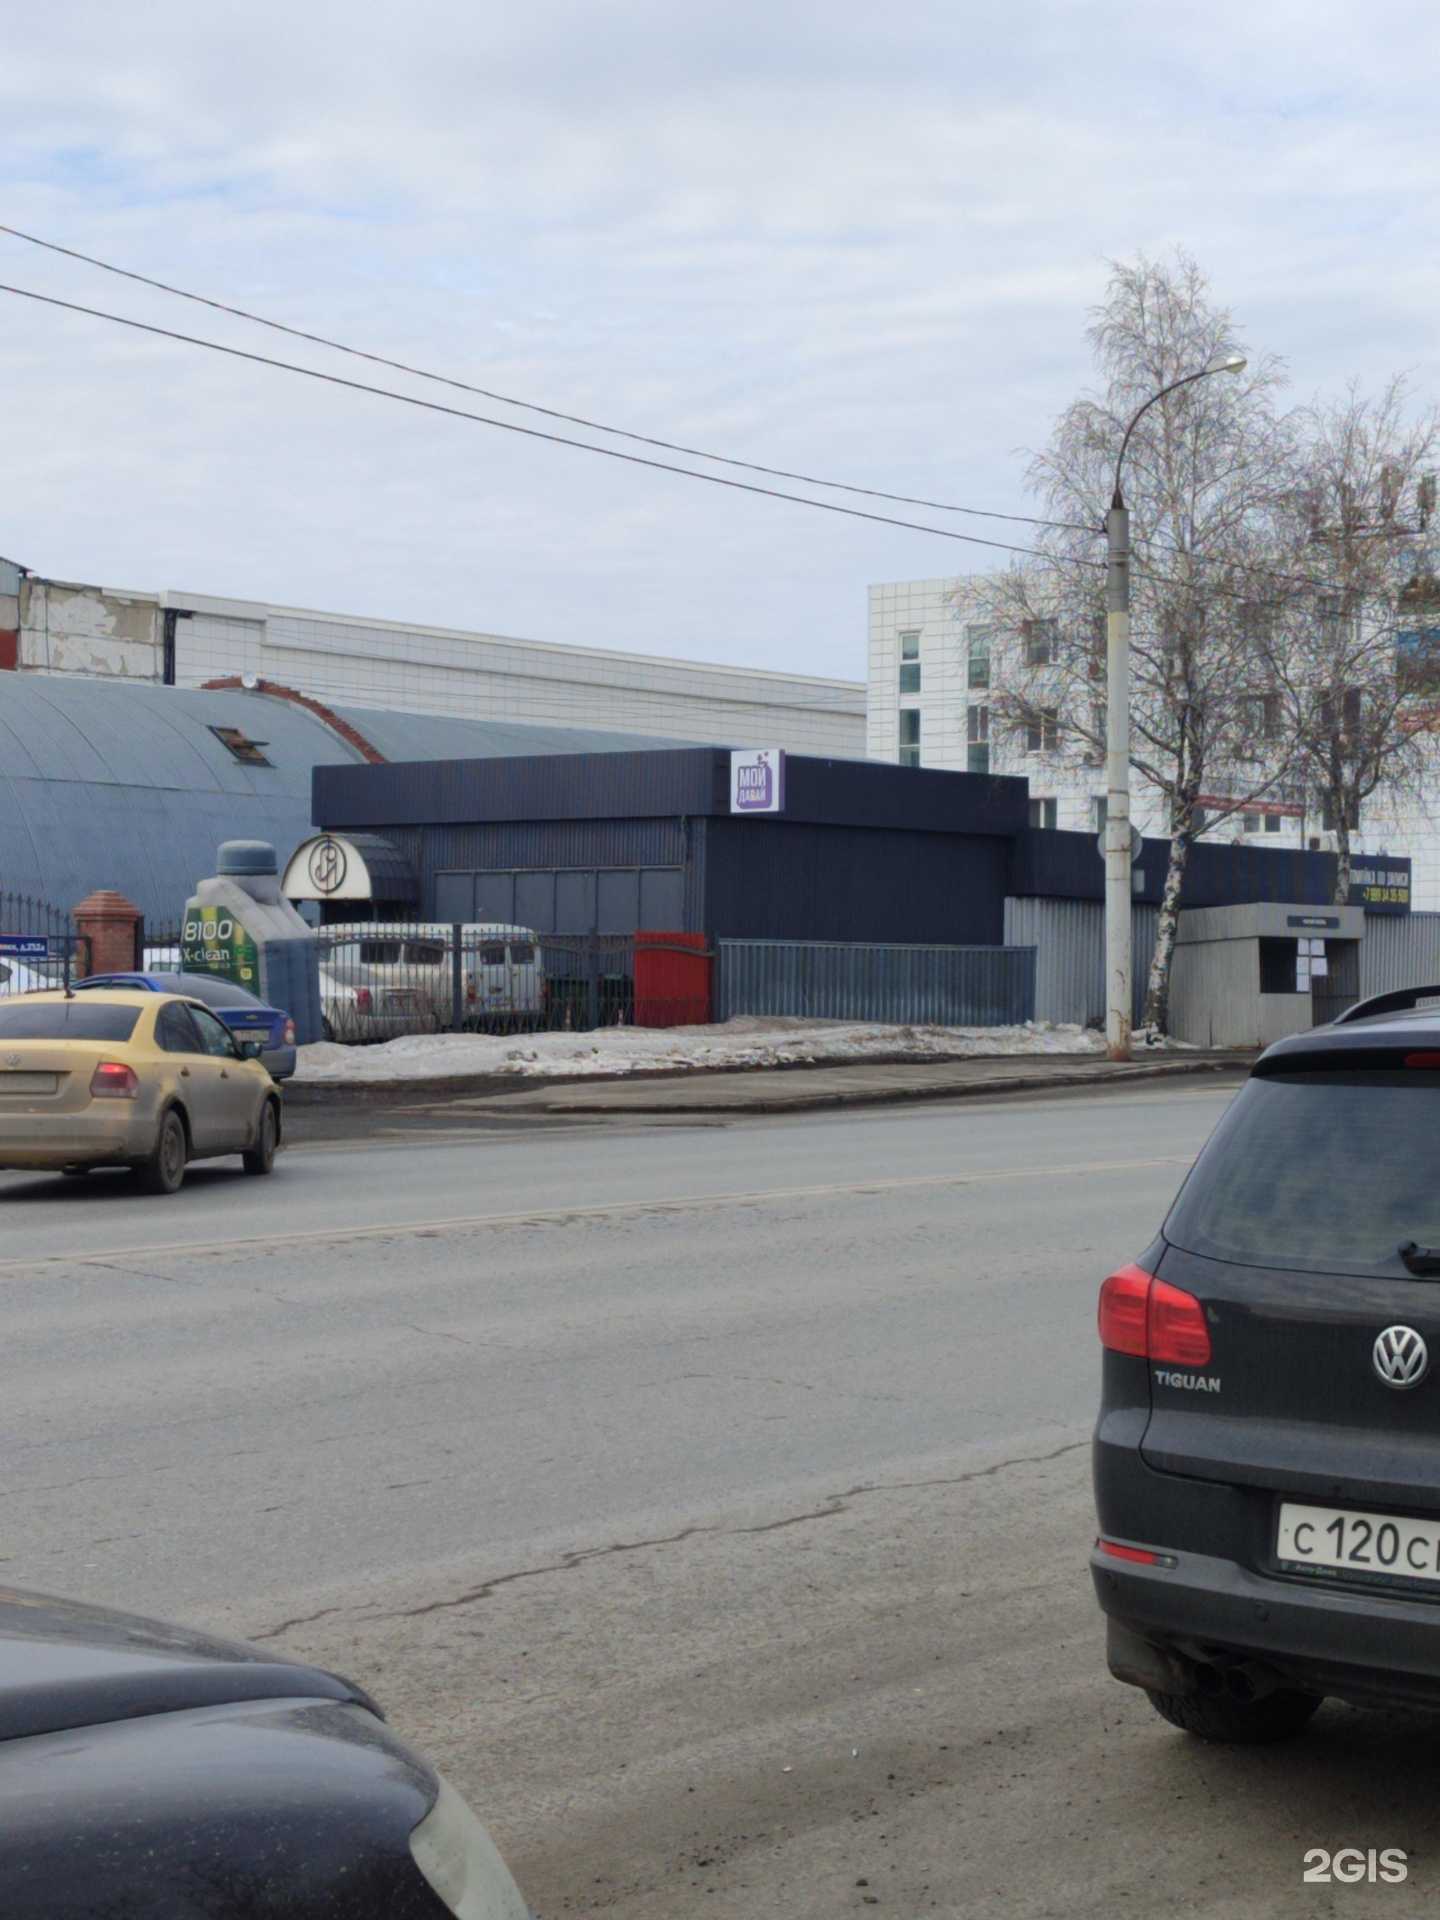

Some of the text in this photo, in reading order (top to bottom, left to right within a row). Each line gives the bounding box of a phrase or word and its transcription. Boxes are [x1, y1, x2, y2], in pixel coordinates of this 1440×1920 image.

[185, 920, 233, 941] 8100
[183, 948, 230, 962] X-clean
[1155, 1370, 1221, 1393] TIGUAN
[1294, 1516, 1440, 1572] С120С
